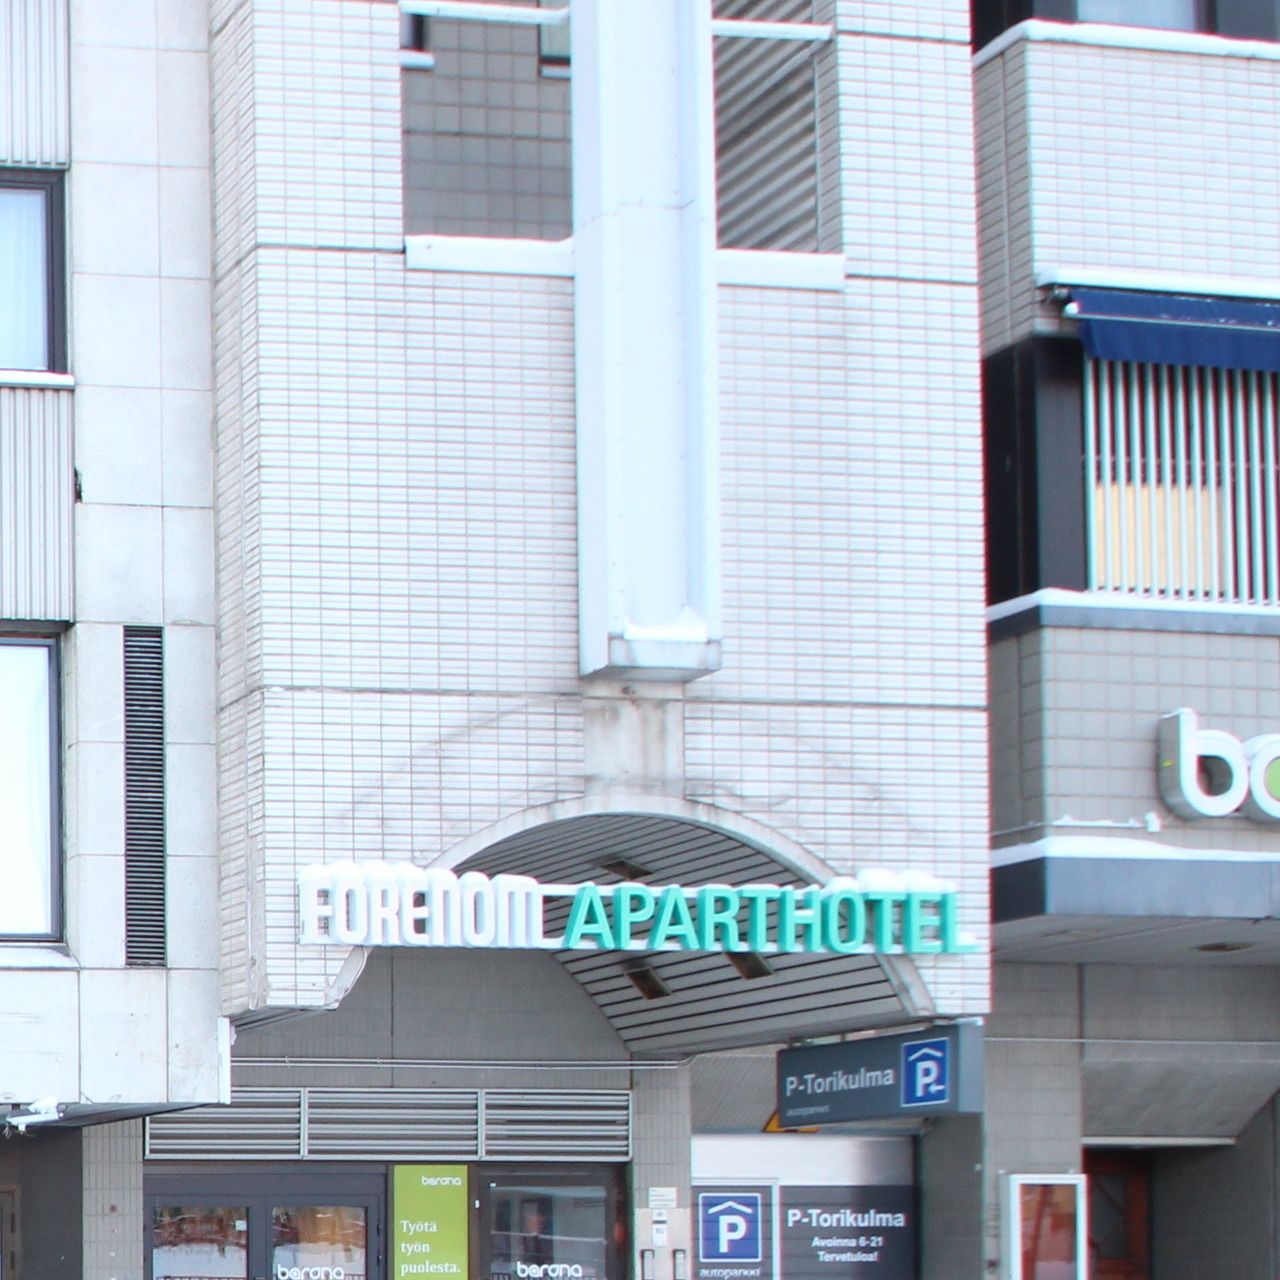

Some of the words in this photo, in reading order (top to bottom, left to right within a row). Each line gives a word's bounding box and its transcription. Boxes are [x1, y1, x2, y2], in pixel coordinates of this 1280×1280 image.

[300, 866, 545, 948] FORENOM
[563, 882, 978, 954] APARTHOTEL
[786, 1067, 895, 1096] P-Torikulma
[787, 1209, 905, 1227] P-Torikulma
[400, 1219, 437, 1234] Työtä
[719, 1215, 747, 1253] P
[401, 1240, 430, 1255] työn
[811, 1236, 856, 1247] Avoinna
[859, 1236, 883, 1247] 6-21
[817, 1251, 878, 1262] Tervetuloa!
[277, 1264, 344, 1280] barona
[401, 1260, 461, 1276] puolesta.
[516, 1262, 582, 1278] barona
